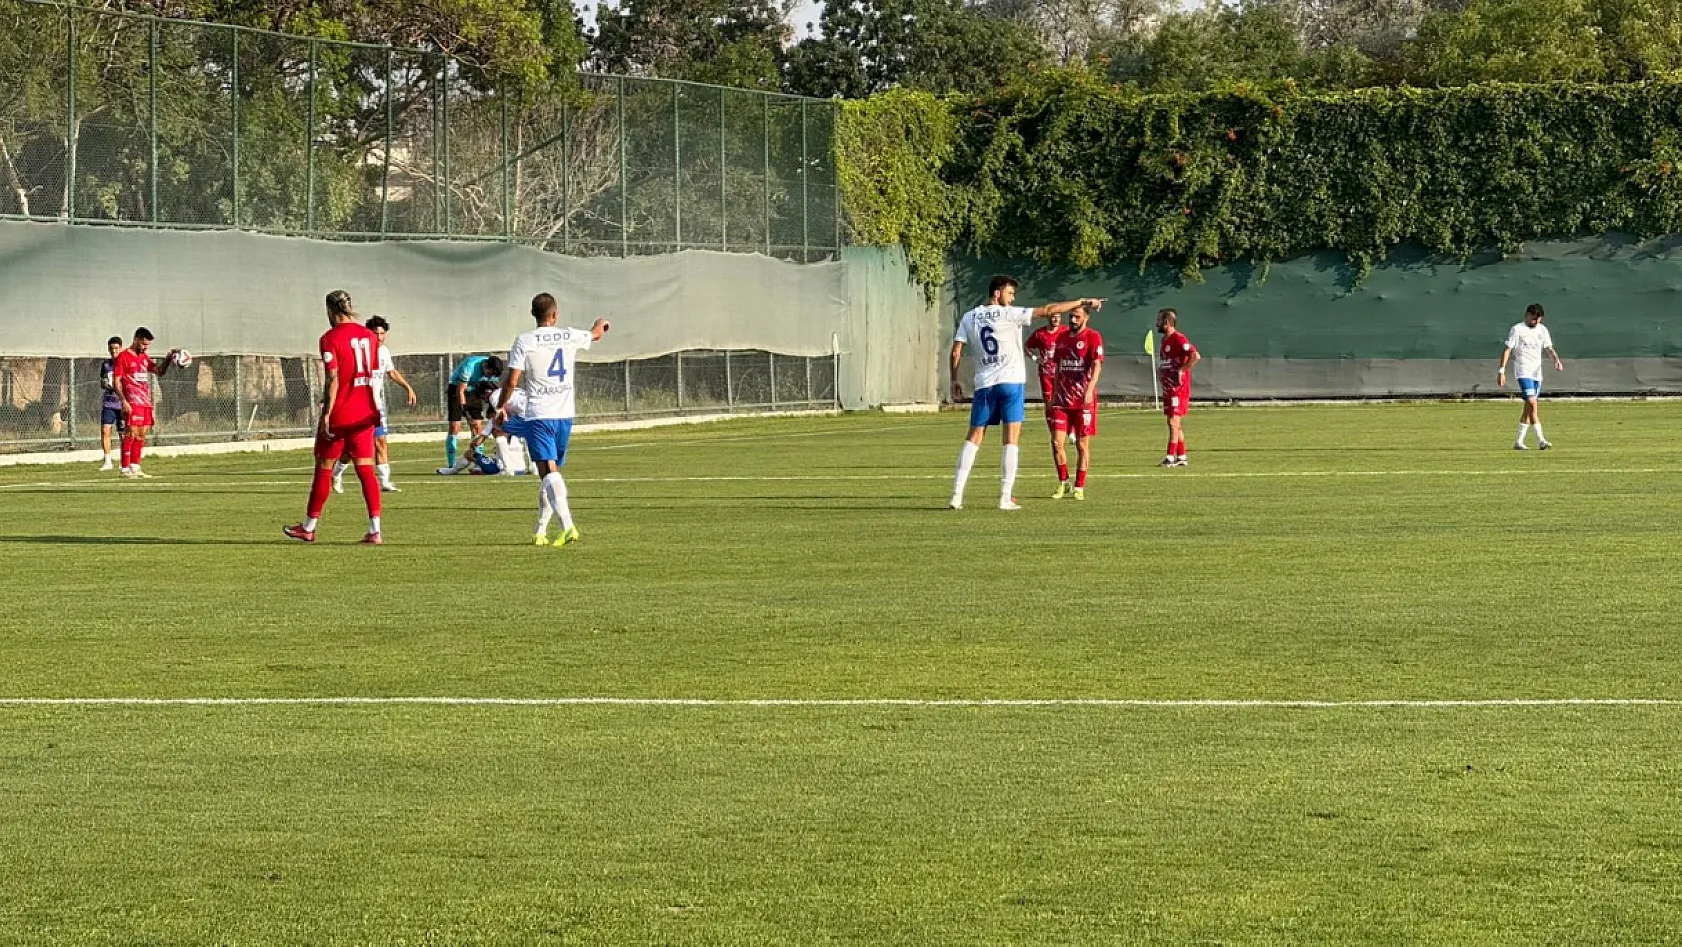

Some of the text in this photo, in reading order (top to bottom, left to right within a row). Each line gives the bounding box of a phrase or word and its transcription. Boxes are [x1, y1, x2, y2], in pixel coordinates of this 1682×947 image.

[350, 337, 370, 372] 11
[981, 325, 999, 355] 6
[547, 347, 567, 382] 4
